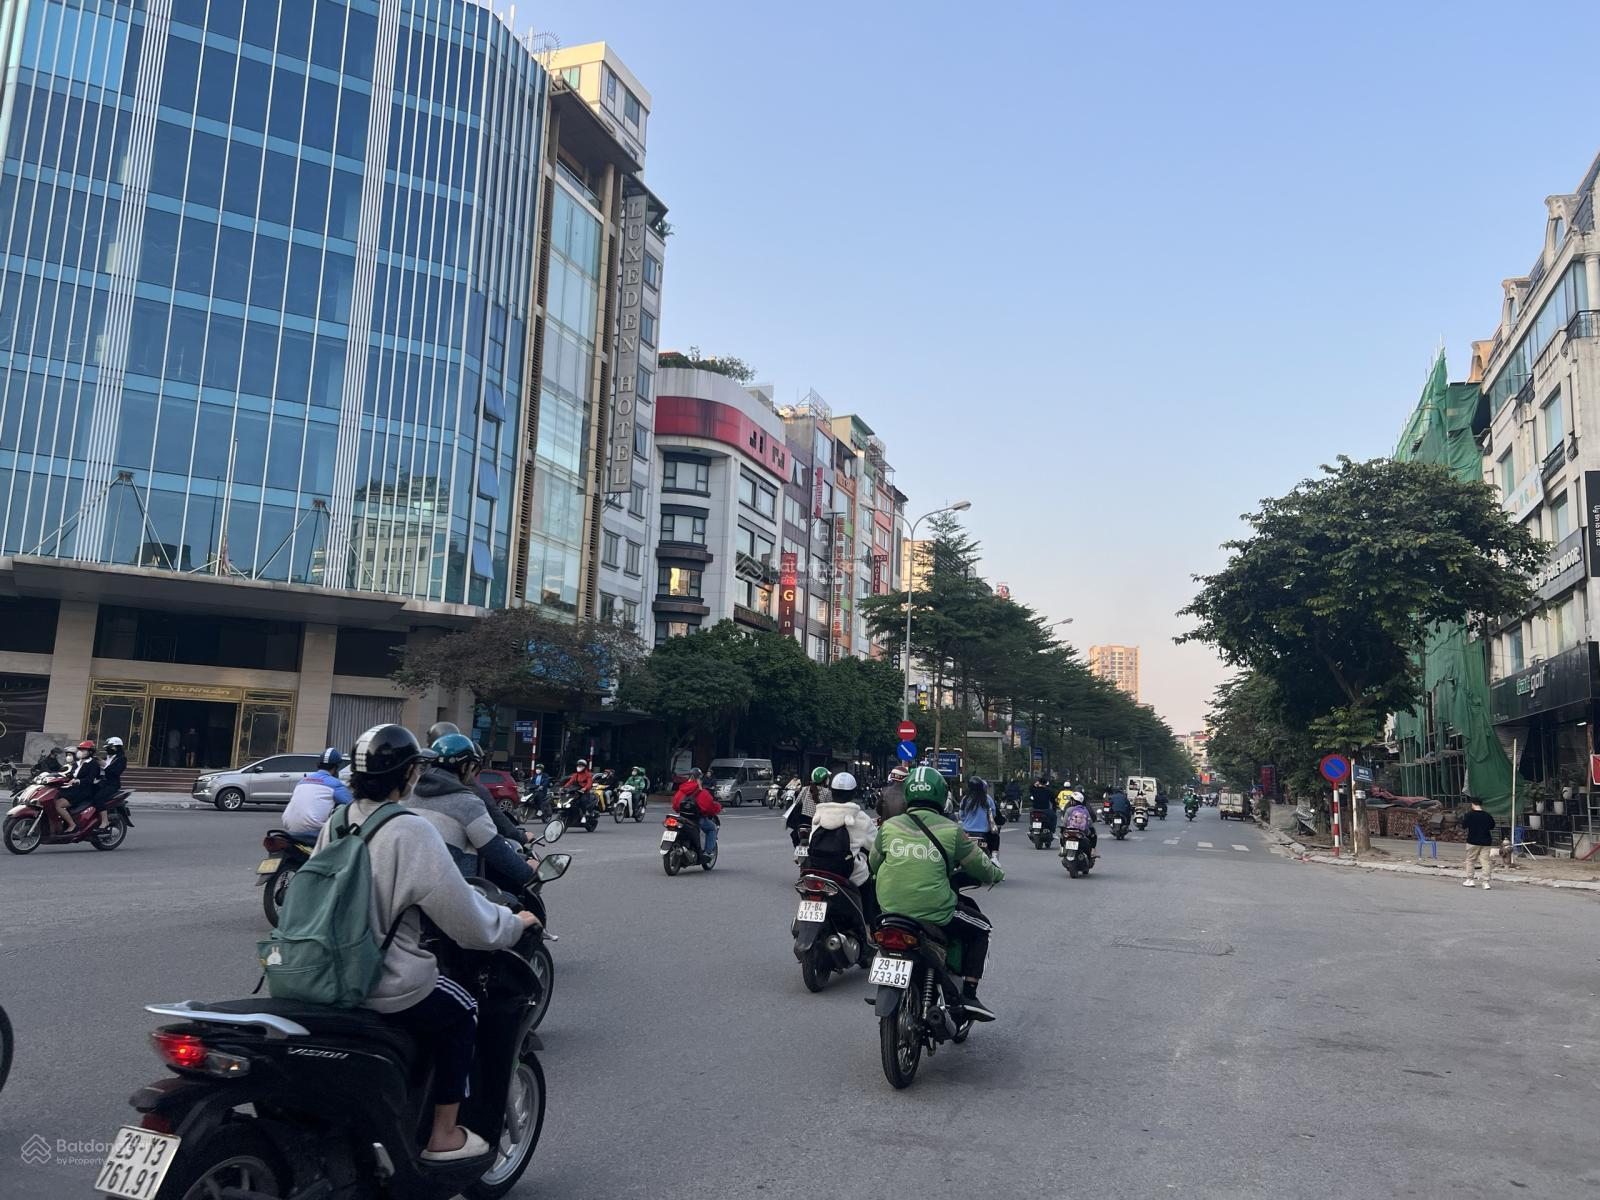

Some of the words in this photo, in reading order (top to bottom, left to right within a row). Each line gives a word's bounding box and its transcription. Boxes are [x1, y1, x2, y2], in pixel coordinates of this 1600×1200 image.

[621, 202, 643, 353] LUXEDEN
[613, 375, 635, 486] HOTEL
[909, 782, 931, 792] Grab
[890, 838, 942, 863] Grab
[878, 958, 906, 972] 29-V1
[871, 970, 908, 986] 733.85
[287, 1046, 349, 1060] VISION
[97, 1159, 159, 1198] 761.91
